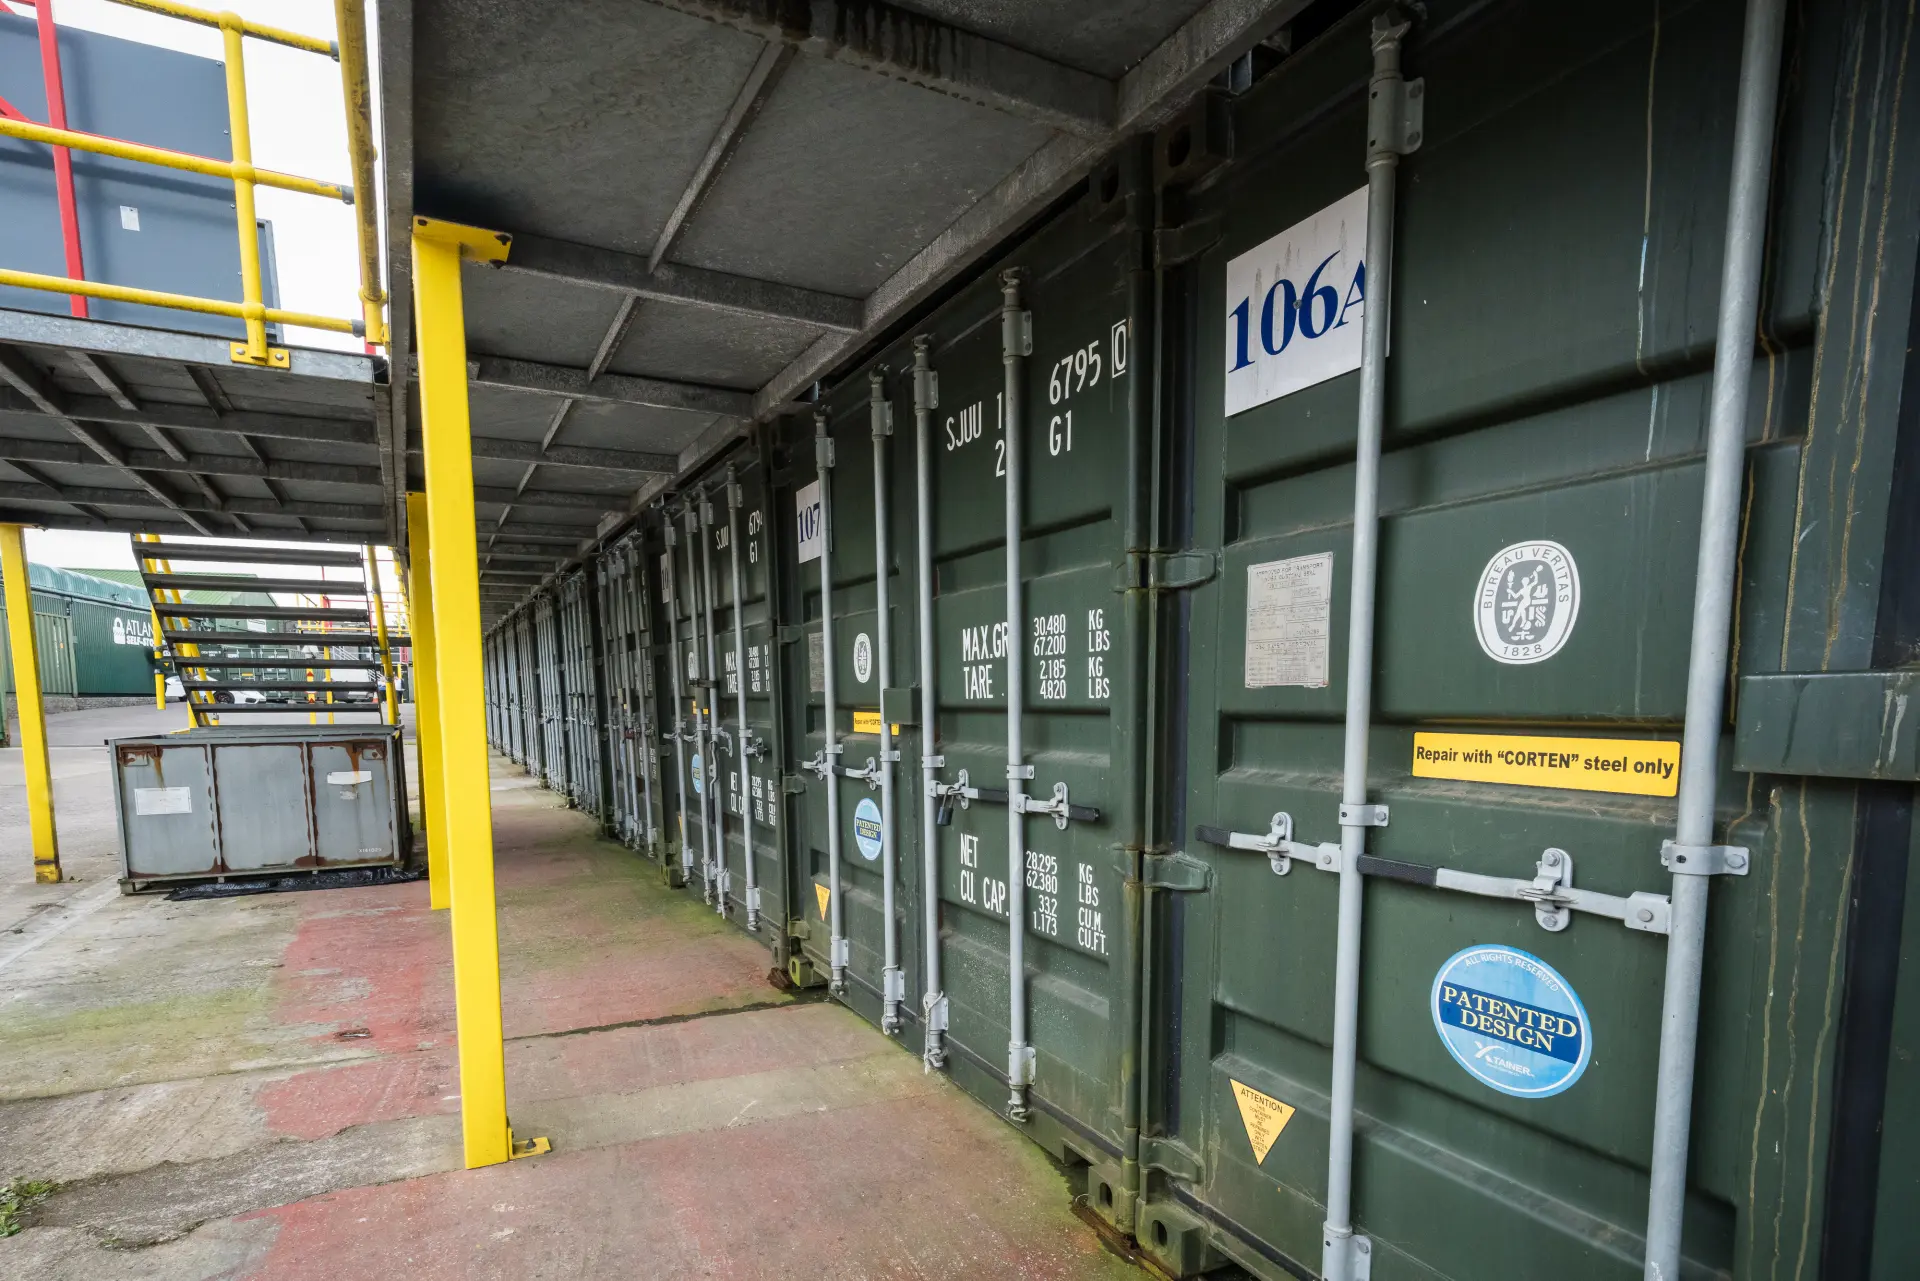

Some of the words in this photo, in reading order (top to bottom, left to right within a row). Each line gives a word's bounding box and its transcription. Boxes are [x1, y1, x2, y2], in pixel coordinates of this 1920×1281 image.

[1228, 250, 1365, 373] 106A
[946, 401, 982, 451] SJUU
[1050, 340, 1101, 405] 6795
[1050, 410, 1072, 456] G1
[1484, 550, 1523, 608] BUREAU
[1532, 548, 1569, 602] VERITAS
[1034, 614, 1066, 636] 30.480
[1088, 609, 1103, 630] KG
[1034, 635, 1066, 656] 67.200
[1088, 630, 1110, 652] LBS
[1503, 644, 1542, 656] 1828
[963, 664, 993, 699] TARE
[1040, 659, 1066, 679] 2.185
[1088, 656, 1103, 677] KG
[1040, 679, 1066, 699] 4.820
[1088, 678, 1110, 699] LBS
[1416, 746, 1459, 763] Repair
[1462, 749, 1492, 763] with
[1497, 750, 1579, 769] “CORTEN”
[1583, 755, 1627, 772] steel
[1633, 758, 1674, 779] only
[856, 819, 880, 832] PATENTED
[960, 833, 978, 868] NET
[1026, 851, 1057, 874] 28.295
[1079, 862, 1092, 884] KG
[961, 870, 976, 904] CU.
[983, 877, 1009, 916] CAP.
[1038, 895, 1057, 917] 33.2
[1078, 907, 1104, 933] CU.M.
[1026, 870, 1057, 894] 62.380
[1079, 883, 1099, 906] LBS
[1033, 911, 1057, 936] 1.173
[1078, 927, 1109, 955] CU.FT.
[1464, 955, 1481, 966] ALL
[1481, 953, 1513, 964] RIGHTS
[1514, 957, 1559, 992] RESERVED
[1443, 985, 1577, 1038] PATENTED
[1460, 1008, 1554, 1052] DESIGN
[1240, 1087, 1283, 1114] ATTENTION
